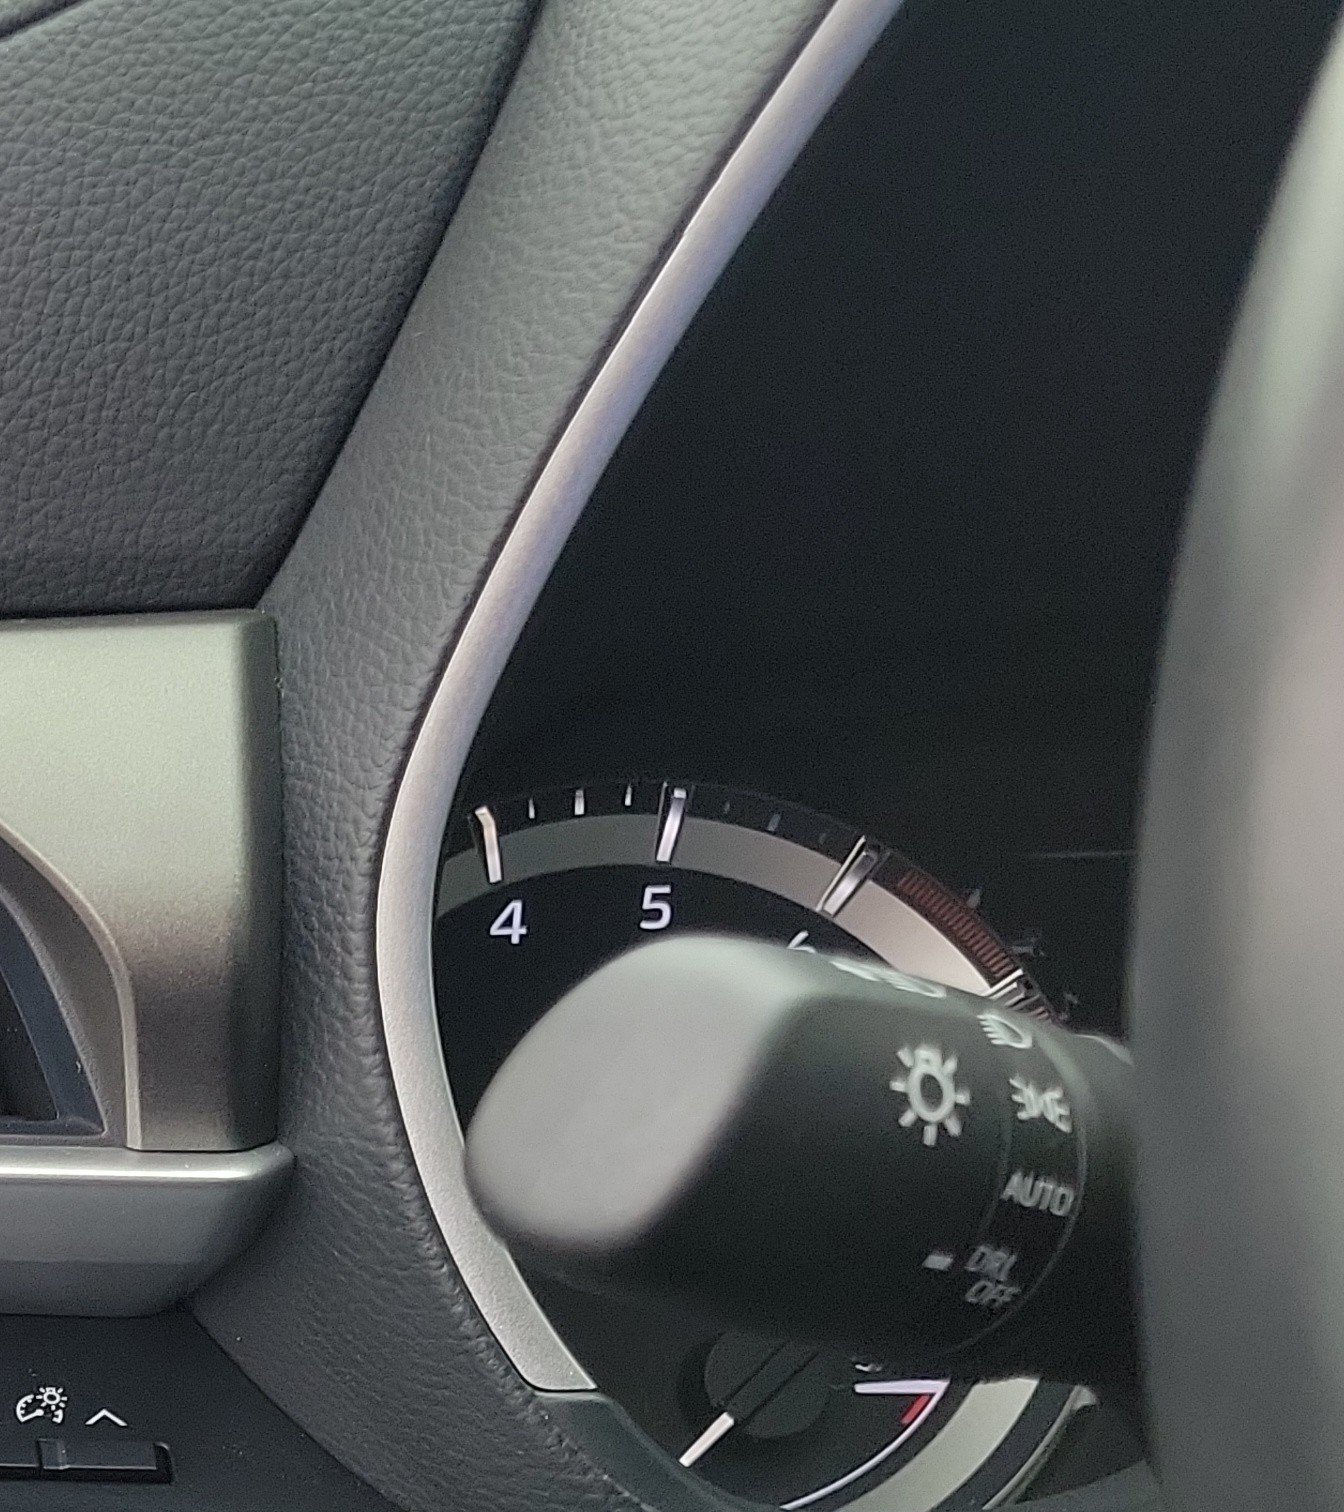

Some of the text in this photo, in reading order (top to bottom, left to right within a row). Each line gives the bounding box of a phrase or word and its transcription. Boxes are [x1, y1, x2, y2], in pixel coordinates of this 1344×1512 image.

[489, 899, 528, 945] 4
[638, 884, 671, 930] 5
[1000, 1170, 1075, 1217] AUTO
[965, 1280, 1022, 1308] OFF
